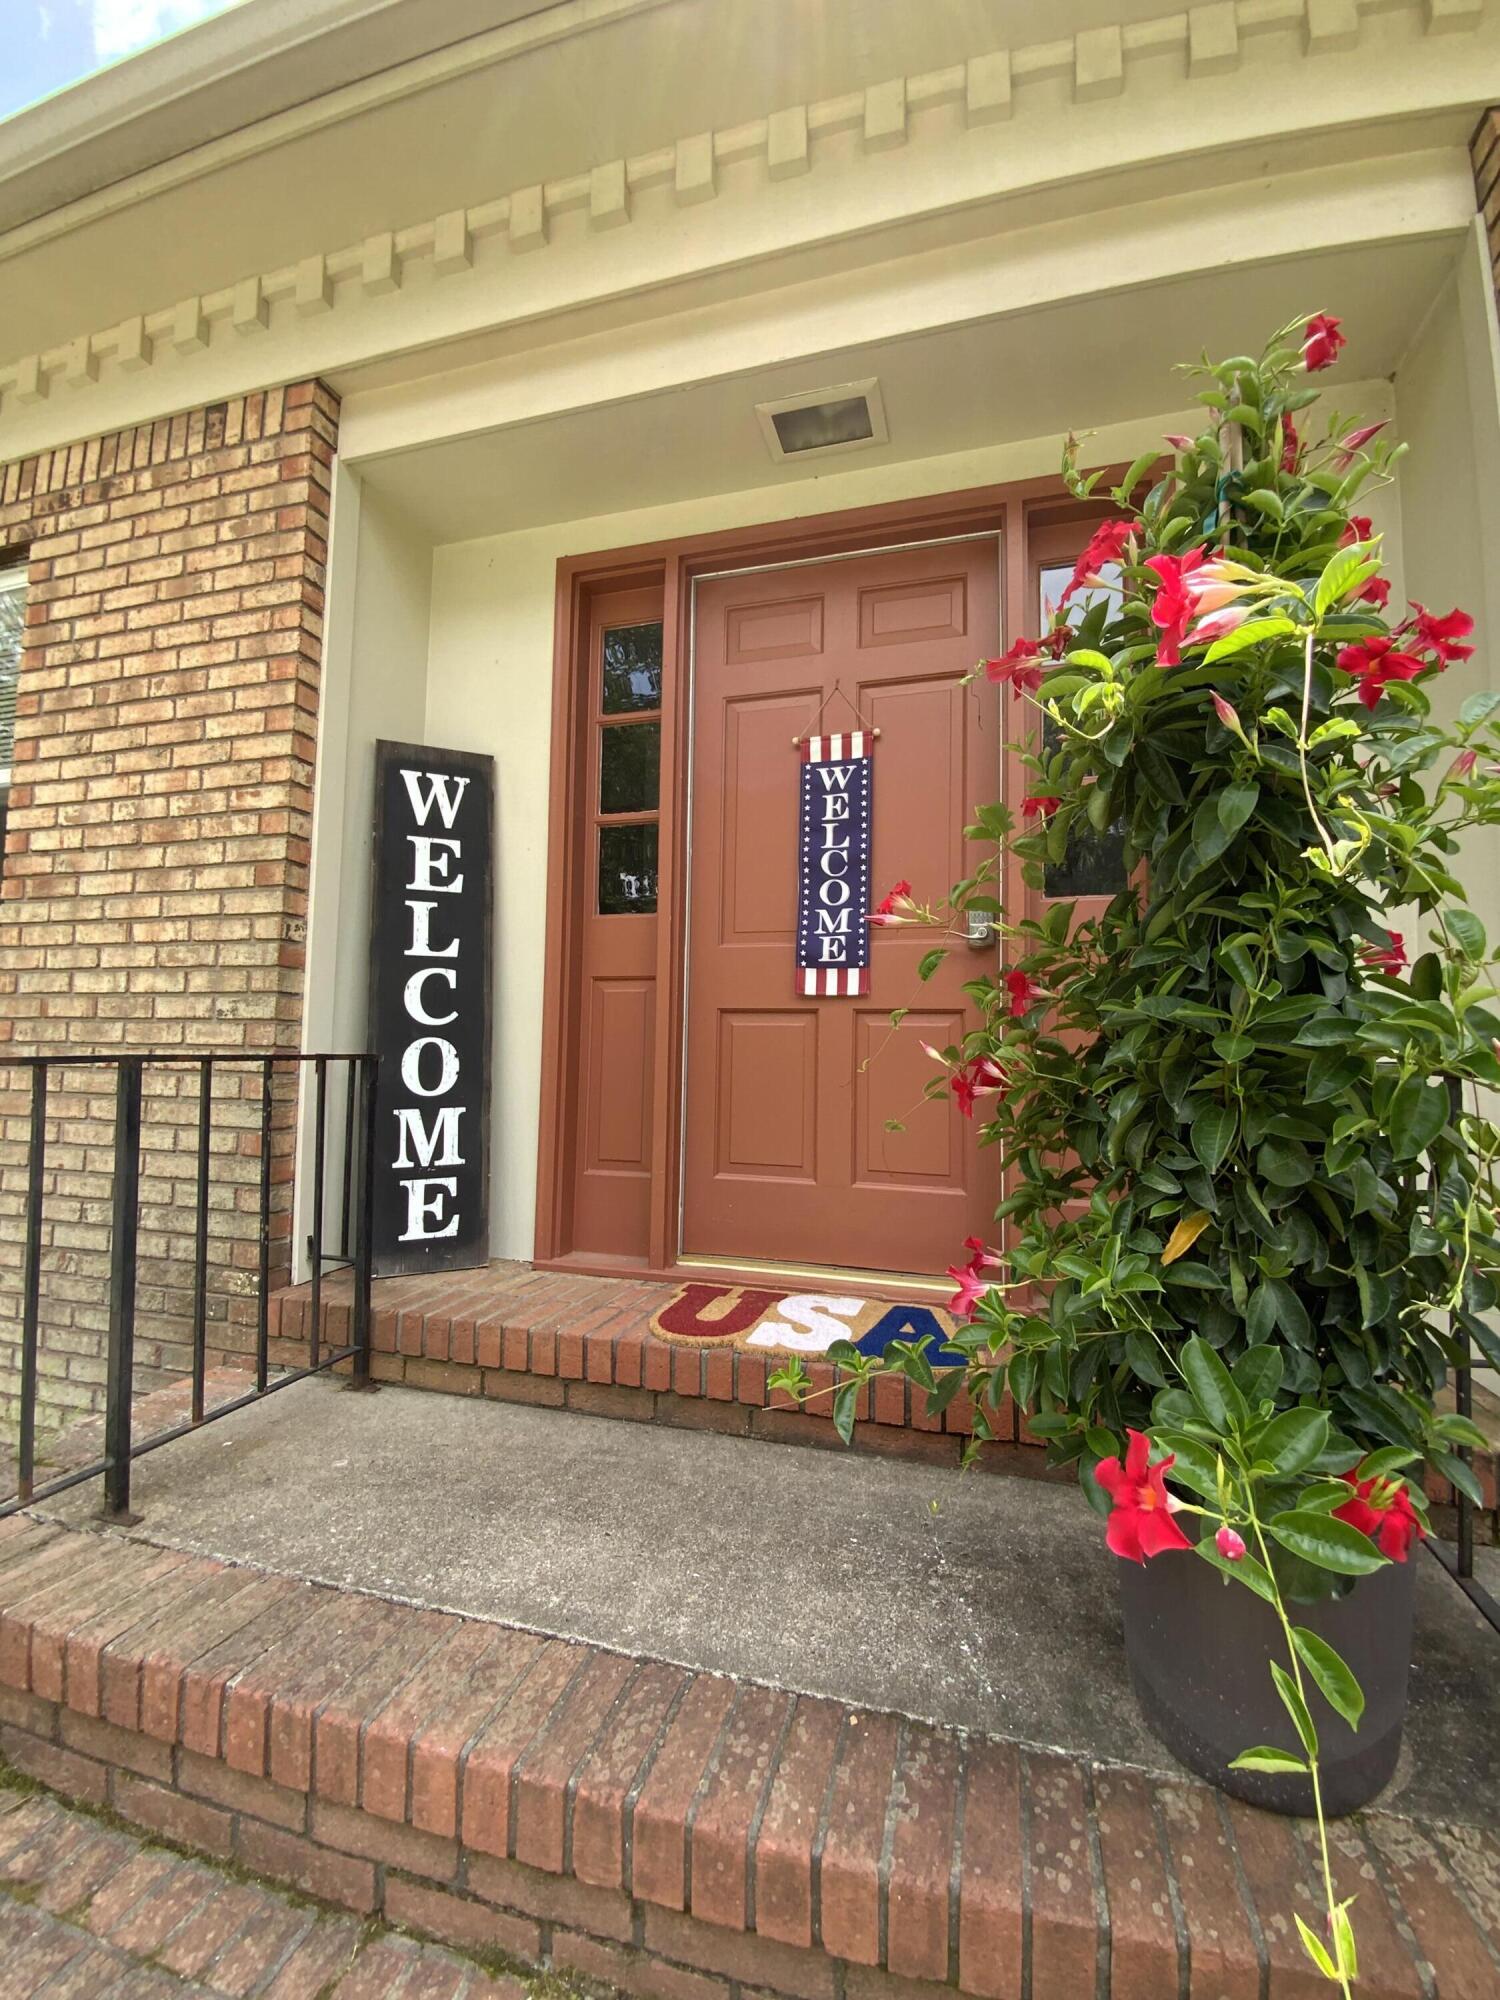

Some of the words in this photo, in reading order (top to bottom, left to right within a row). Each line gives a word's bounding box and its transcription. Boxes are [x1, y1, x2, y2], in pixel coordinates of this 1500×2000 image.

[813, 765, 857, 962] WELCOME
[391, 768, 470, 1241] WELCOME
[658, 1283, 970, 1367] USA
